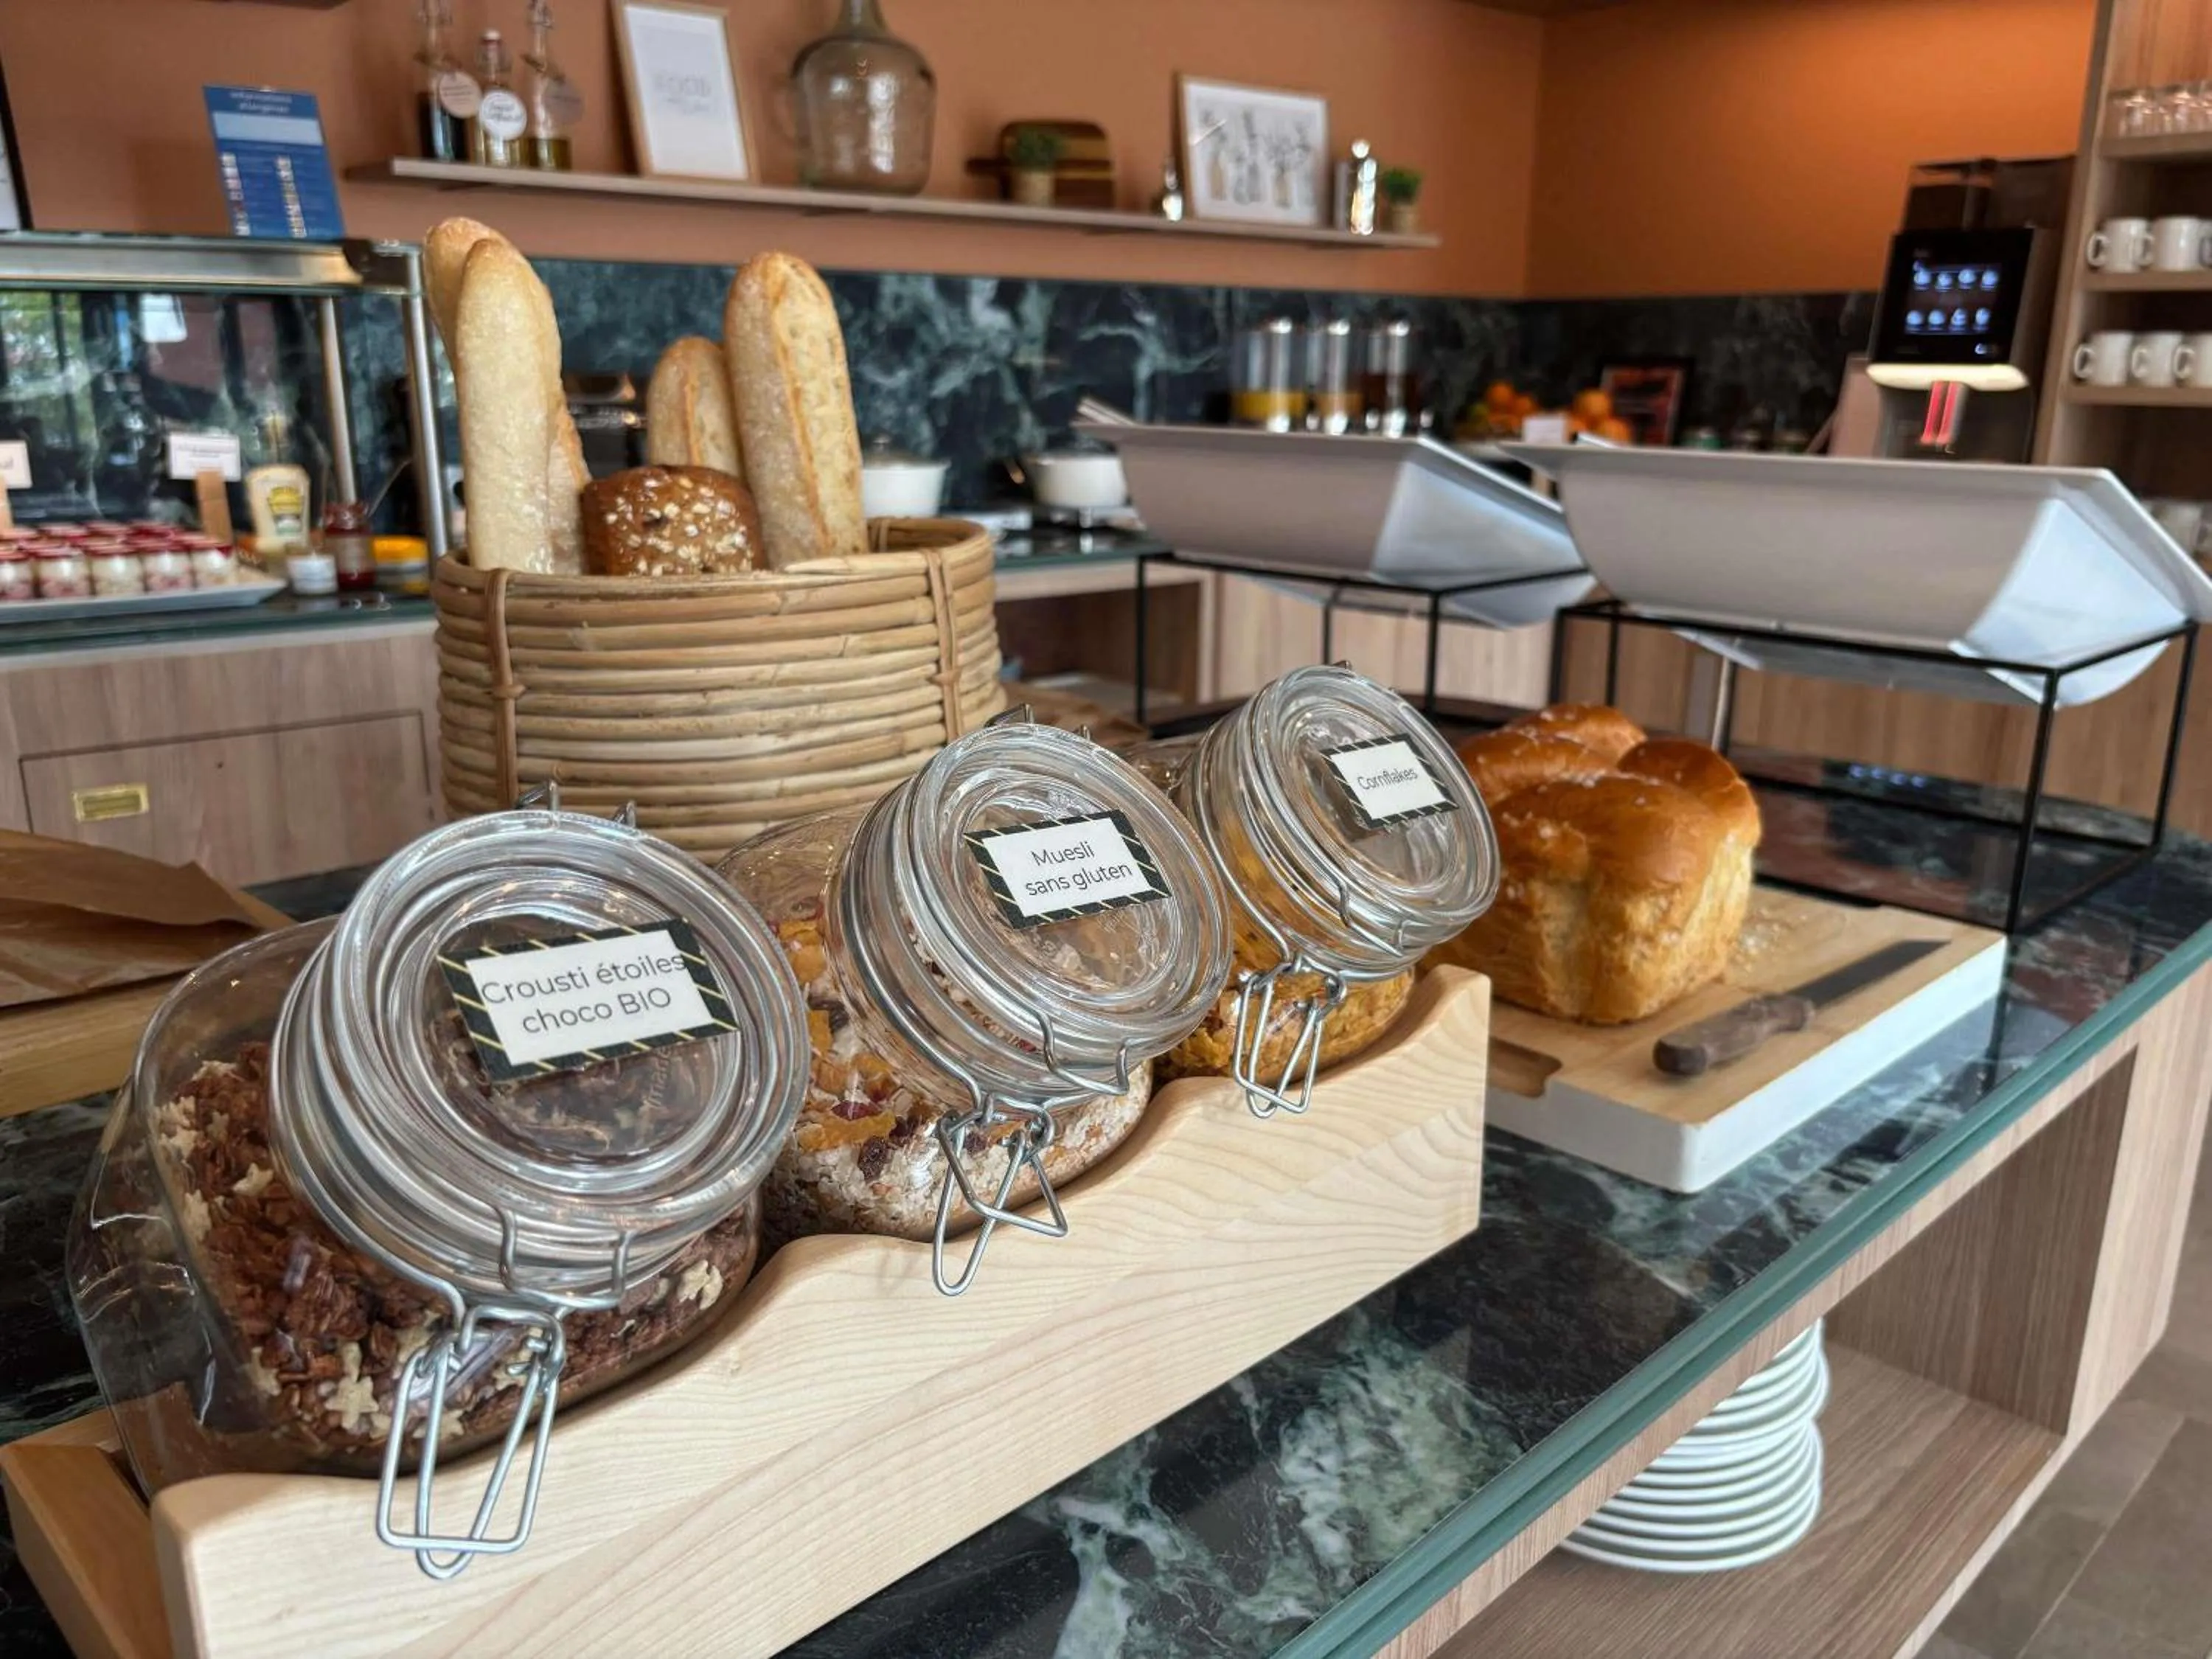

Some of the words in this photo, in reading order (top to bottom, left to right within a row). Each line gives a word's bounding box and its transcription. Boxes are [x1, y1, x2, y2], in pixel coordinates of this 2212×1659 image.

[1357, 768, 1418, 790] Cornflakes
[1032, 841, 1095, 866] Muesli
[1026, 877, 1070, 896] sans
[1073, 862, 1133, 889] gluten
[481, 967, 590, 1004] Crousti
[596, 953, 688, 984] étoiles
[522, 1001, 613, 1034] choco
[618, 987, 672, 1015] BIO
